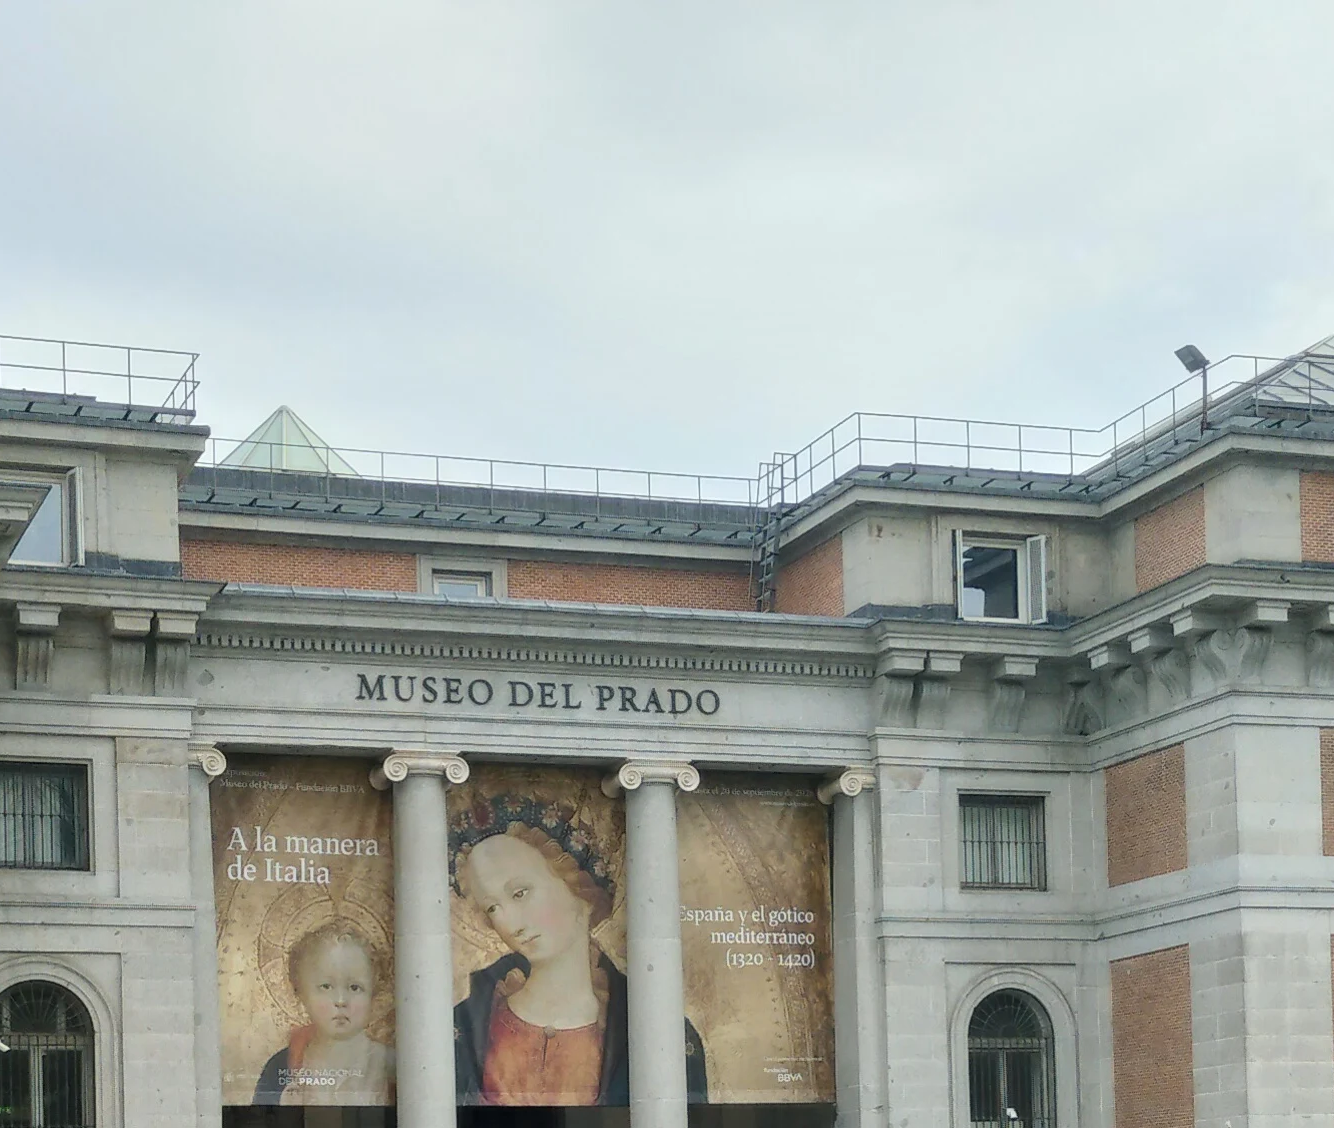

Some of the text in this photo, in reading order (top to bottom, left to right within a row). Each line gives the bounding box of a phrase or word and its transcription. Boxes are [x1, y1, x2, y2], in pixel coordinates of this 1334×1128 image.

[356, 673, 721, 716] MUSEO DEL PRADO
[220, 779, 247, 788] Museo
[248, 780, 262, 788] del
[263, 780, 287, 790] Prado
[296, 782, 338, 793] Fundación
[339, 784, 365, 793] BBVA
[227, 826, 380, 856] A la manera
[227, 855, 331, 884] de Italia
[680, 905, 814, 927] España y el gótico
[711, 927, 815, 945] mediterráneo
[726, 948, 764, 969] (1320
[778, 948, 815, 969] 1420)
[278, 1068, 364, 1077] MUSEO NACIONAL
[278, 1077, 336, 1086] DEL PRADO
[777, 1073, 803, 1082] BBVA
